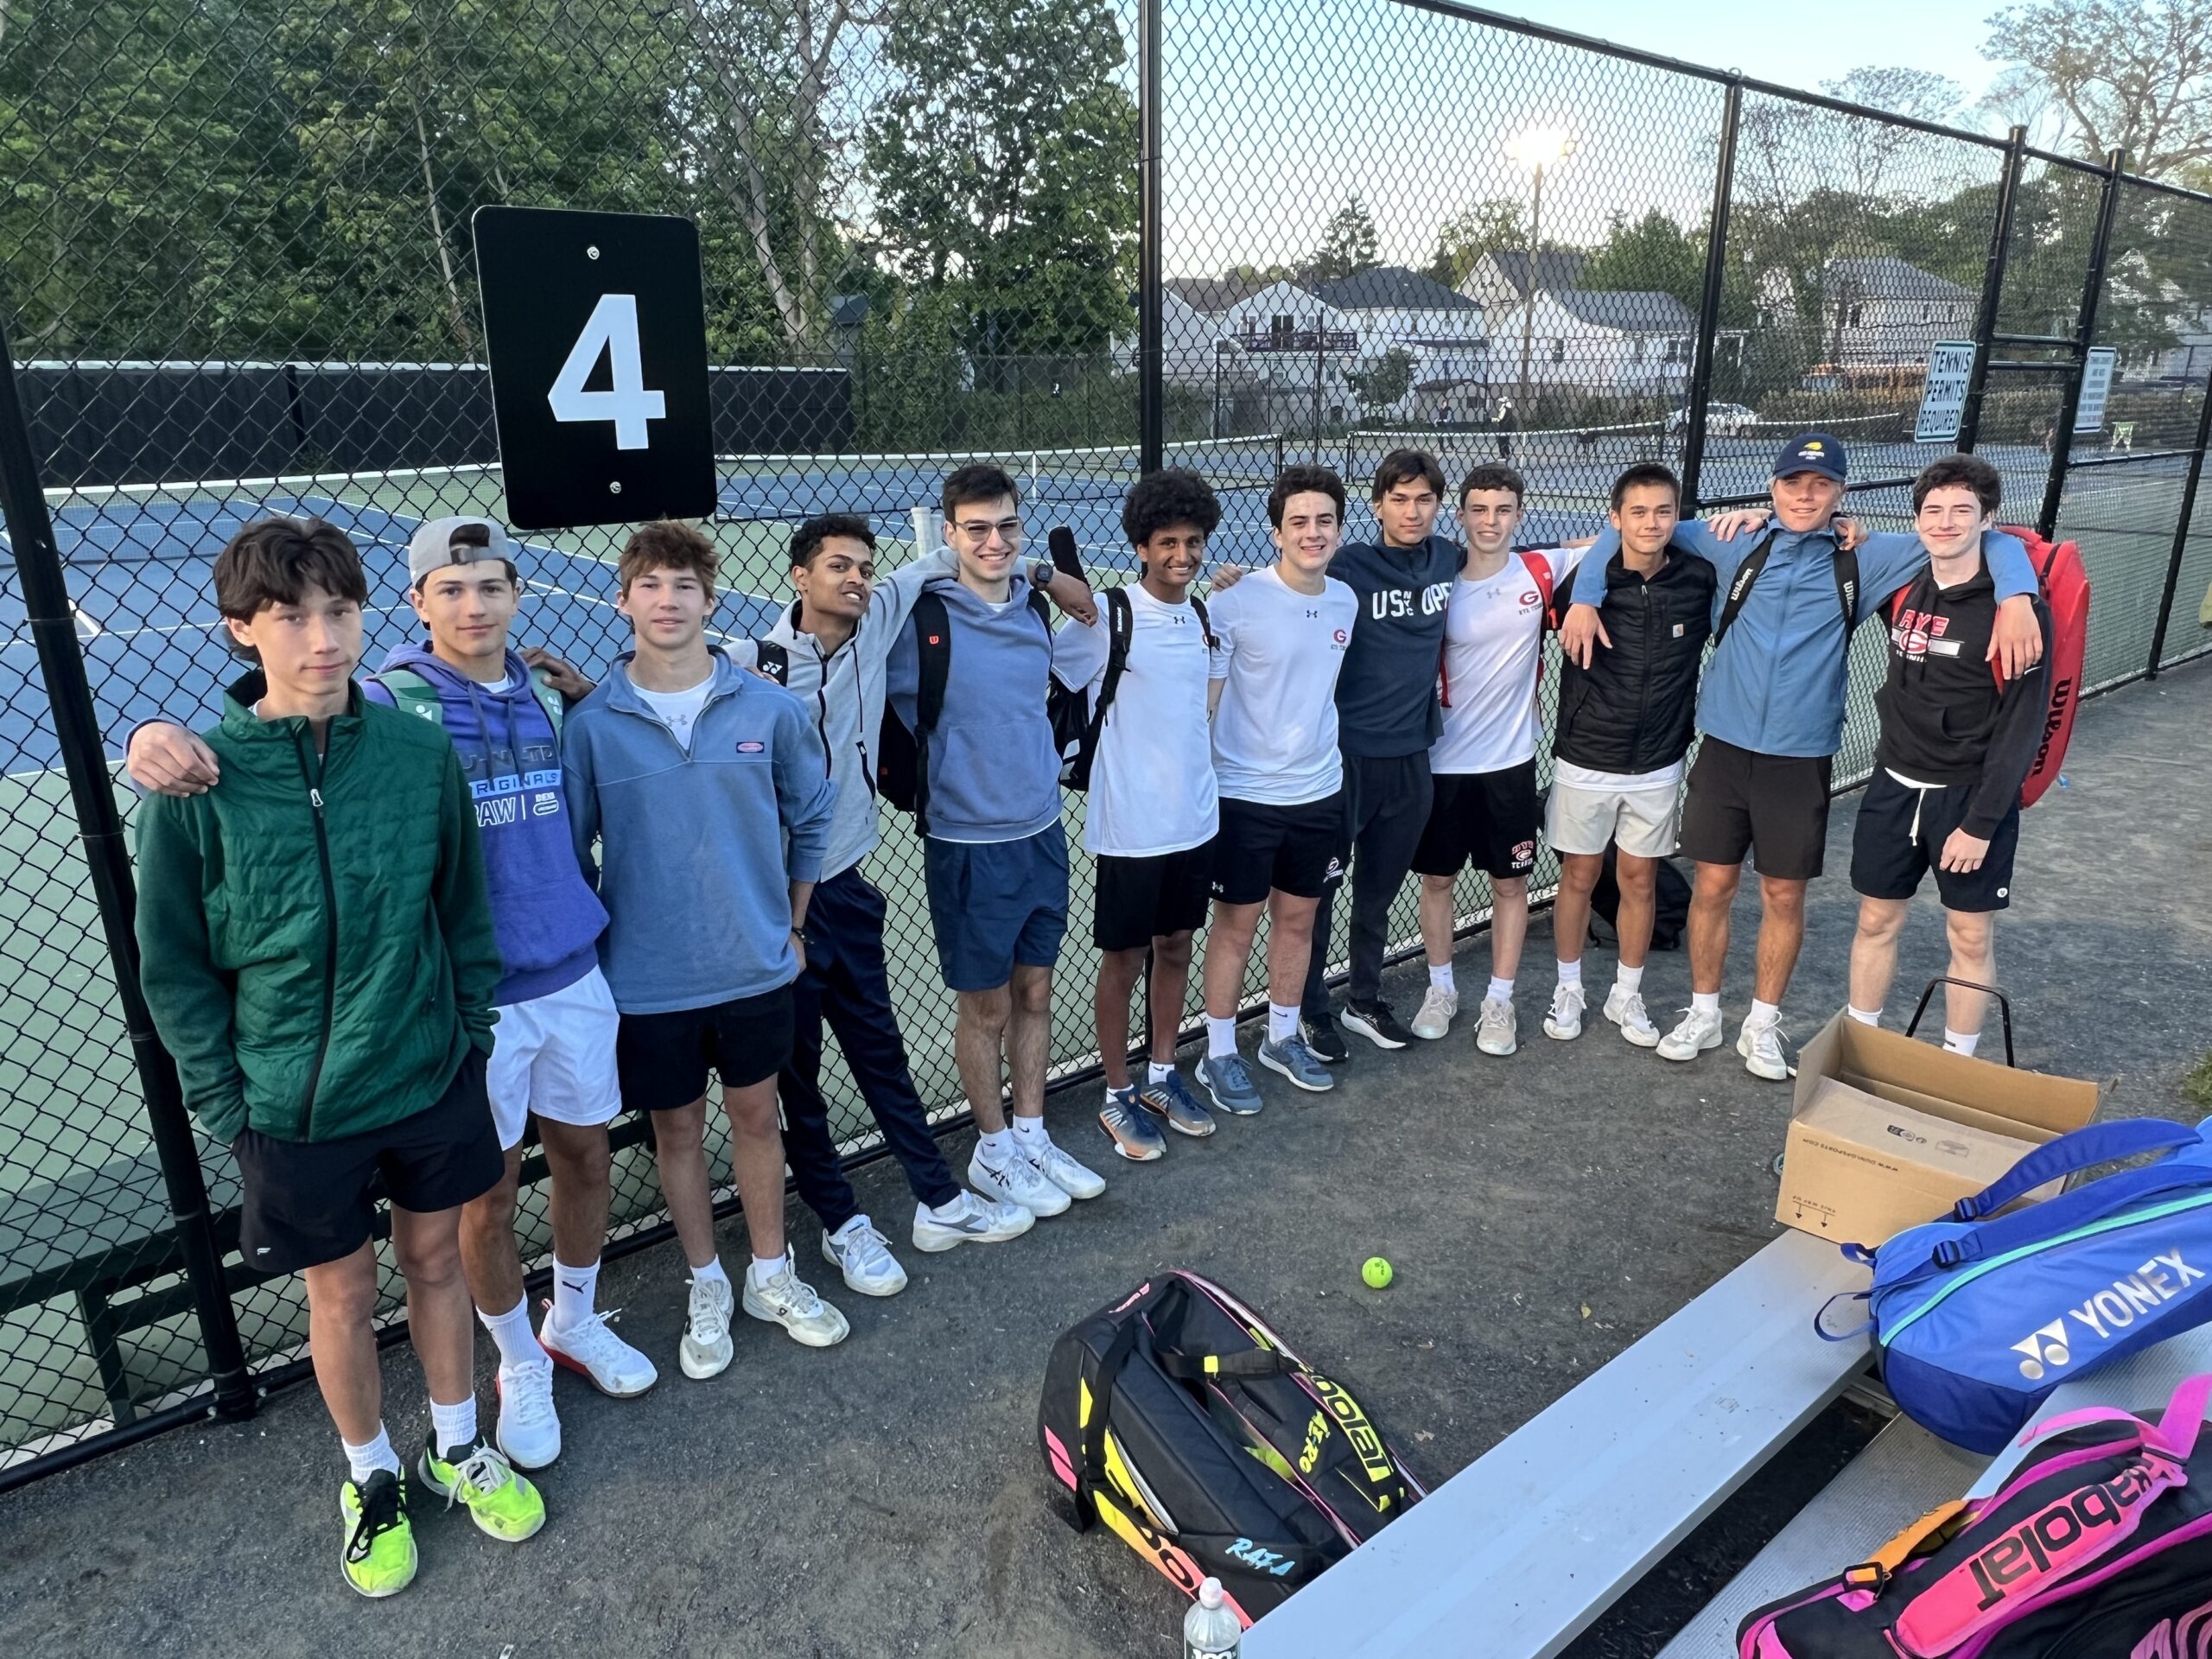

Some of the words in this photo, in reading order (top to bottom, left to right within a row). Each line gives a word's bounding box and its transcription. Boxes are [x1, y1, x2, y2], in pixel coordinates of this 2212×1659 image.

[547, 294, 666, 450] 4
[1932, 351, 1971, 373] TENNIS
[1924, 380, 1966, 402] PERMITS
[1918, 410, 1960, 433] REQUIRED
[1372, 589, 1405, 620] US
[1421, 582, 1452, 615] OPE
[1898, 609, 1949, 632] RYE
[2032, 677, 2072, 776] Wilson
[476, 773, 557, 796] RGINALS
[474, 797, 516, 827] AW
[2068, 1249, 2205, 1338] YONEX
